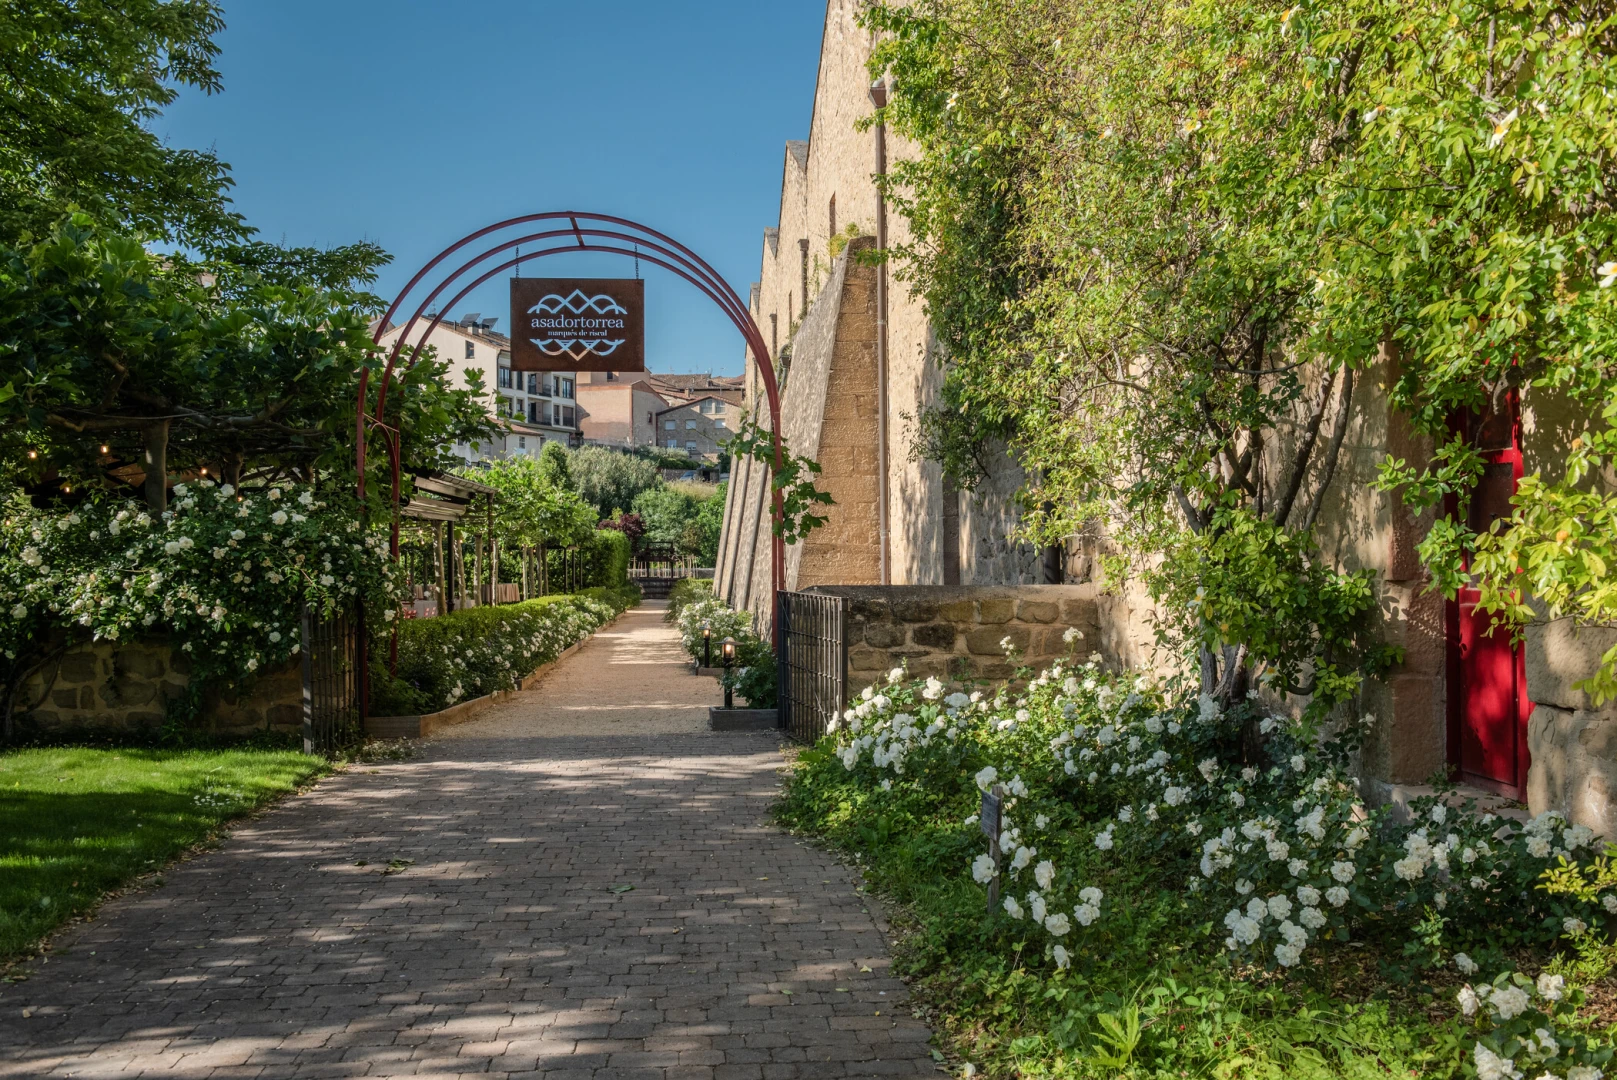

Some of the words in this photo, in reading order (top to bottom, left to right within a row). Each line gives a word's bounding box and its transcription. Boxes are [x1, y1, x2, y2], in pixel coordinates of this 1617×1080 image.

[531, 314, 625, 329] asadortorrea
[548, 329, 577, 338] marqués
[578, 329, 587, 337] de
[589, 329, 608, 337] riscal
